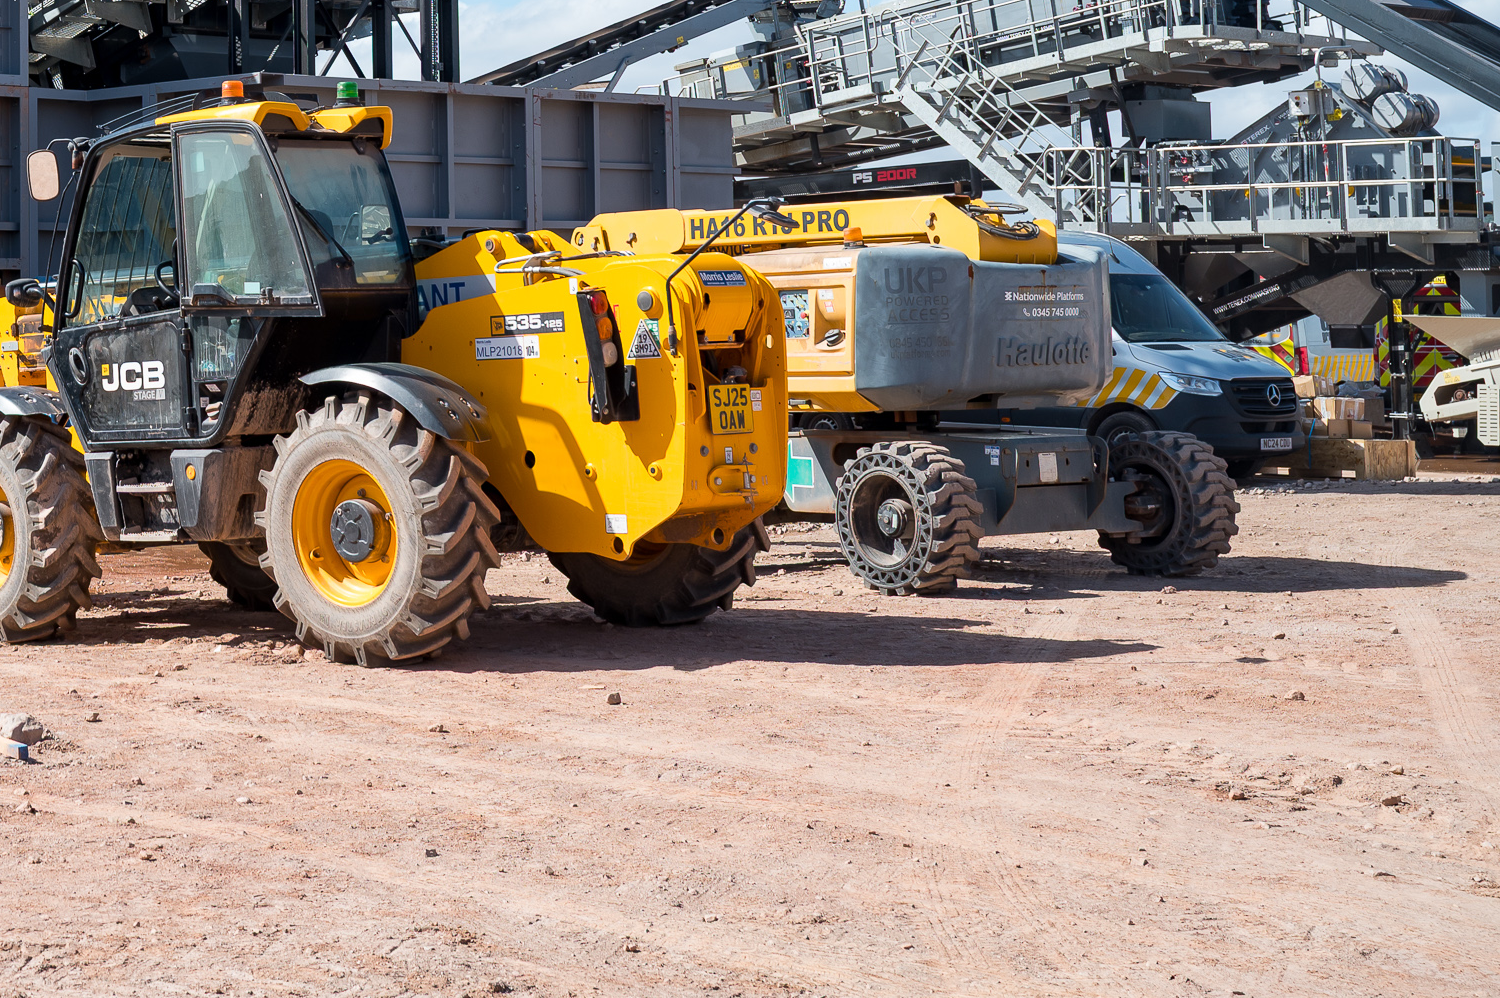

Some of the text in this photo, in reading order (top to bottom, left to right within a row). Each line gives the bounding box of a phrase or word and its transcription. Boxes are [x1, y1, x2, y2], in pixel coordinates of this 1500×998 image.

[852, 168, 917, 184] PS 200R
[801, 208, 850, 233] PRO
[884, 266, 948, 294] UKP
[885, 295, 949, 307] POWERED
[1012, 291, 1084, 301] Nationwide Platforms
[887, 307, 950, 322] ACCESS
[1032, 308, 1050, 317] 0345
[1051, 307, 1064, 317] 745
[997, 336, 1090, 368] Haulotte
[101, 360, 166, 392] JCB
[133, 390, 156, 400] STAGE
[712, 387, 748, 407] SJ25
[719, 409, 746, 430] OAW
